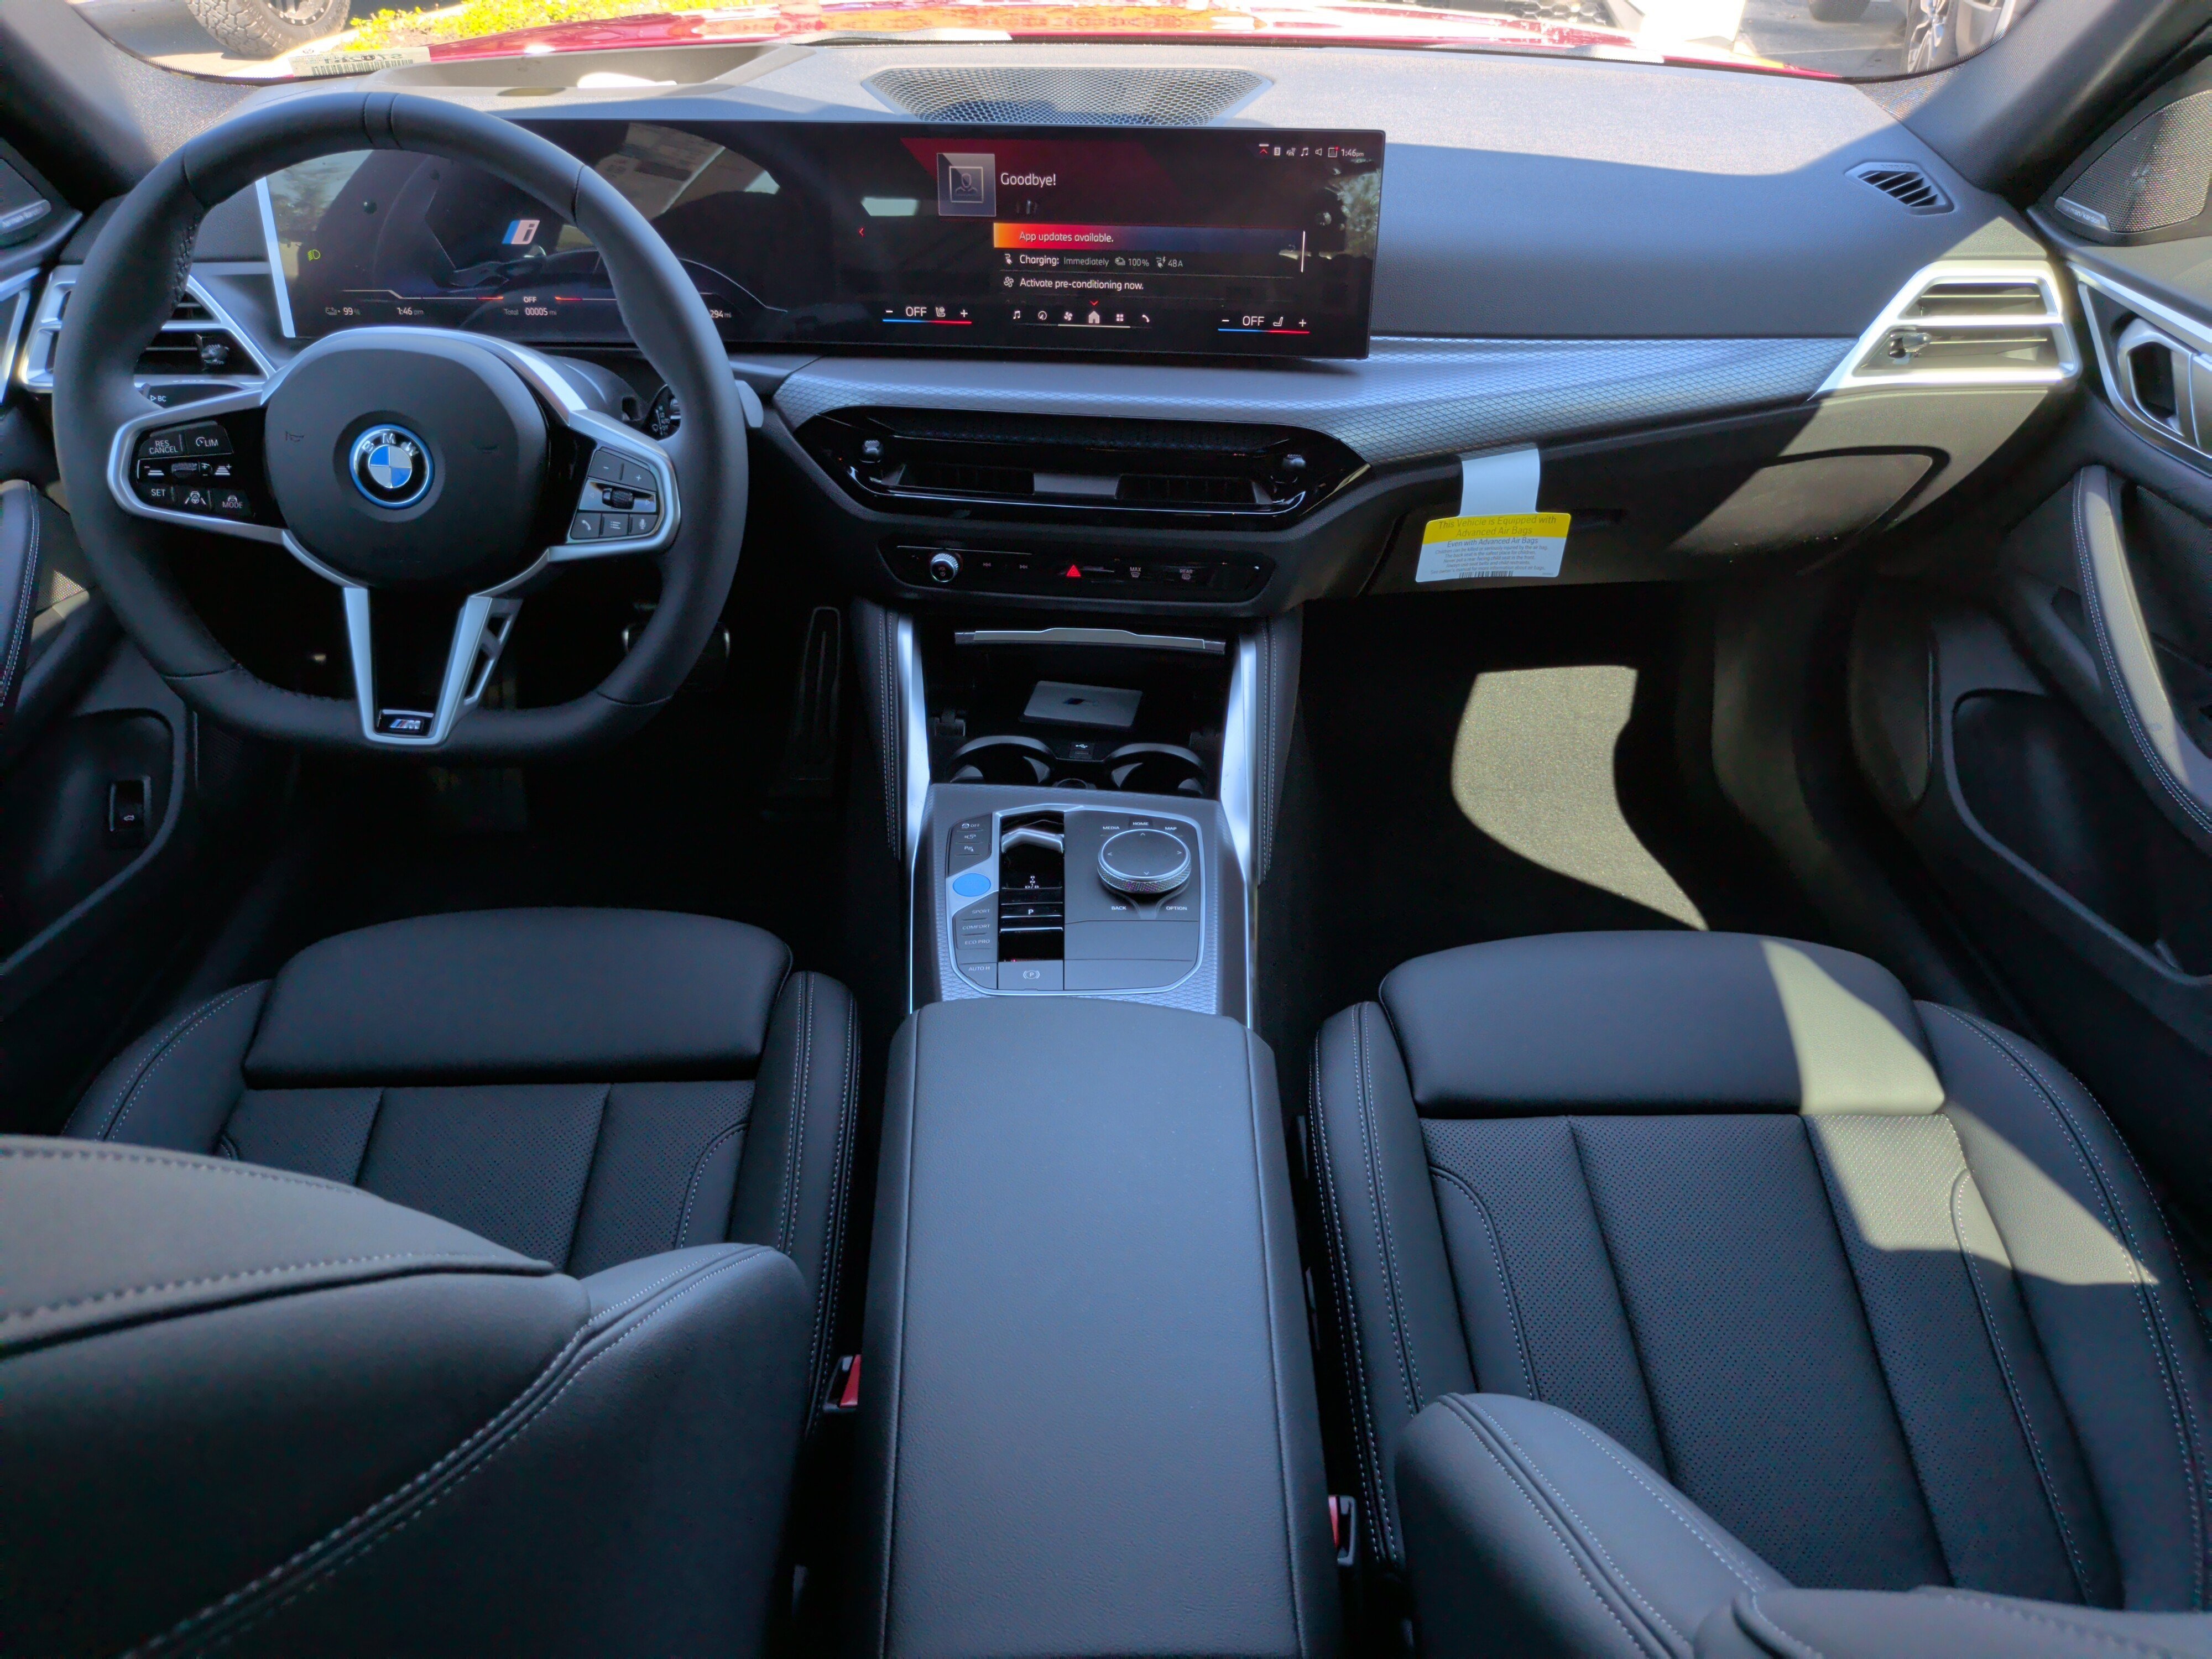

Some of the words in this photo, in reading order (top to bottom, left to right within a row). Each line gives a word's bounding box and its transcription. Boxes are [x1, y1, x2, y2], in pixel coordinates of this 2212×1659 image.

[1000, 173, 1056, 188] Goodbye!
[2065, 205, 2100, 225] man/kardon
[1019, 231, 1036, 242] App
[1038, 232, 1067, 243] updates
[1068, 233, 1114, 243] available.
[1020, 254, 1060, 267] Charging:
[1063, 257, 1109, 267] Immediately
[1020, 278, 1052, 288] Activate
[1055, 278, 1122, 291] pre-conditioning
[525, 307, 548, 316] 00005
[710, 310, 723, 318] 294
[905, 306, 927, 317] OFF
[1243, 316, 1265, 326] OFF
[205, 439, 219, 447] LIM
[362, 433, 419, 456] BMW
[150, 488, 166, 497] SET
[1457, 519, 1486, 527] Vehicle
[1498, 516, 1536, 526] Equipped
[1538, 515, 1557, 524] with
[1456, 528, 1496, 538] Advanced
[1511, 526, 1532, 536] Bags
